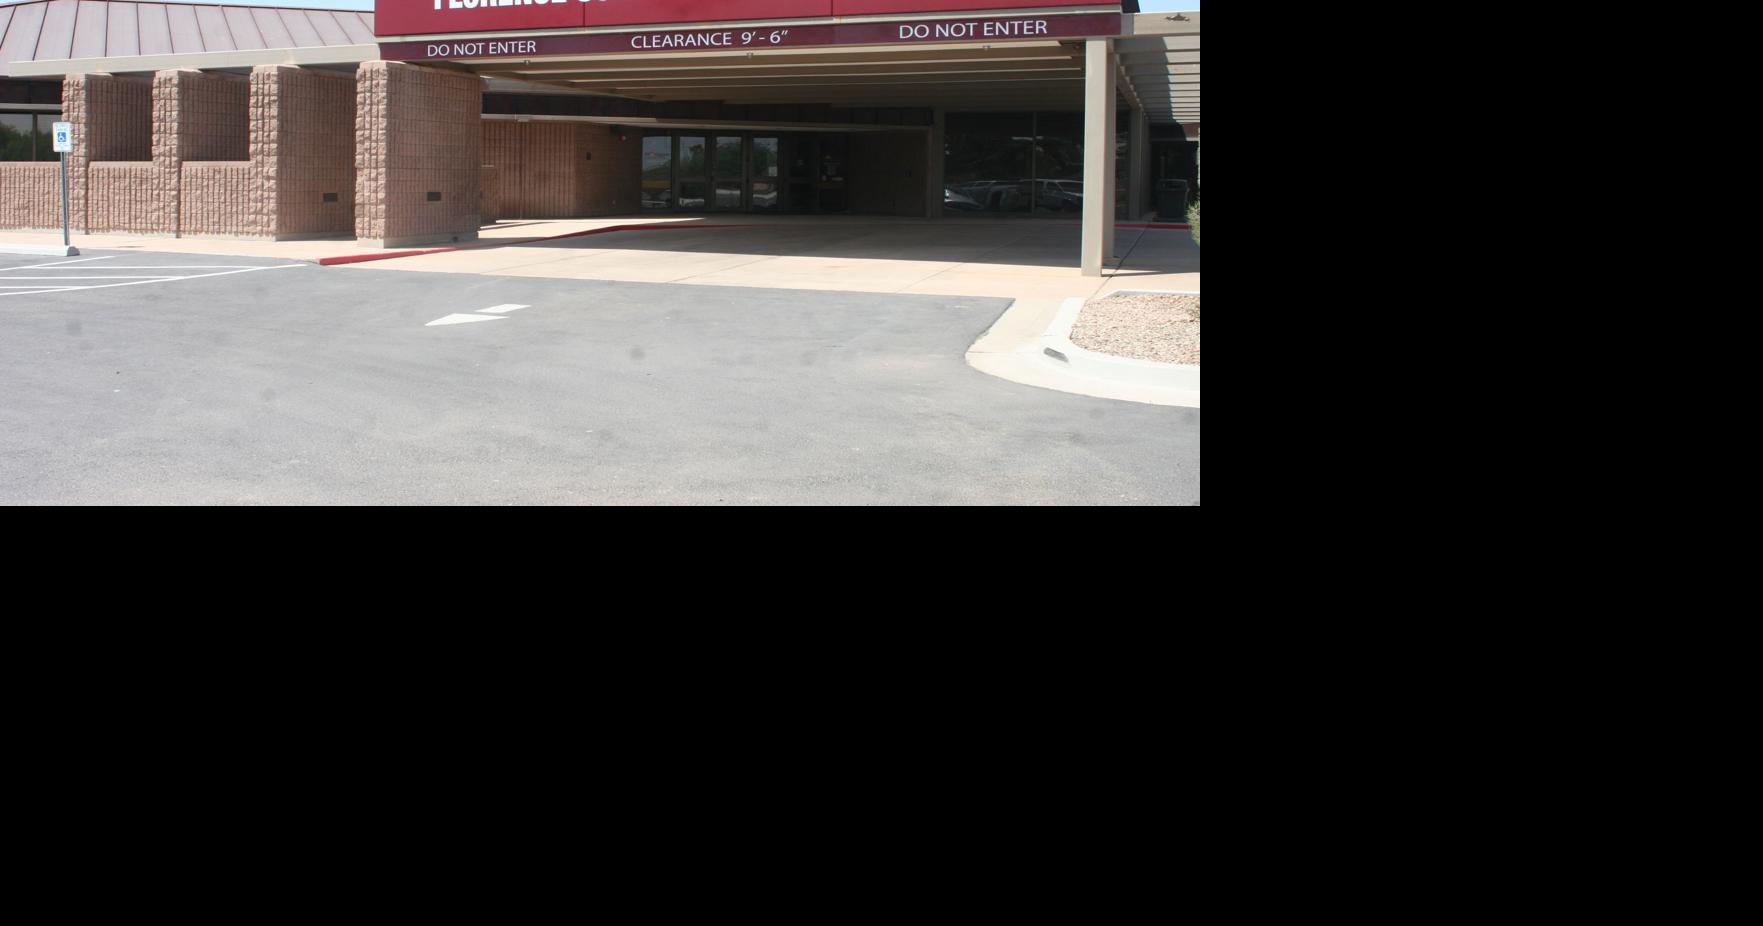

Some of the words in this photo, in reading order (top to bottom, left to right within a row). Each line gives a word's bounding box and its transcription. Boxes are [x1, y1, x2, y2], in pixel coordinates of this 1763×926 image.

[899, 25, 930, 39] DO
[935, 23, 977, 38] NOT
[983, 20, 1048, 37] ENTER
[427, 45, 450, 57] DO
[453, 43, 485, 56] NOT
[489, 41, 537, 55] ENTER
[631, 32, 733, 49] CLEARANCE
